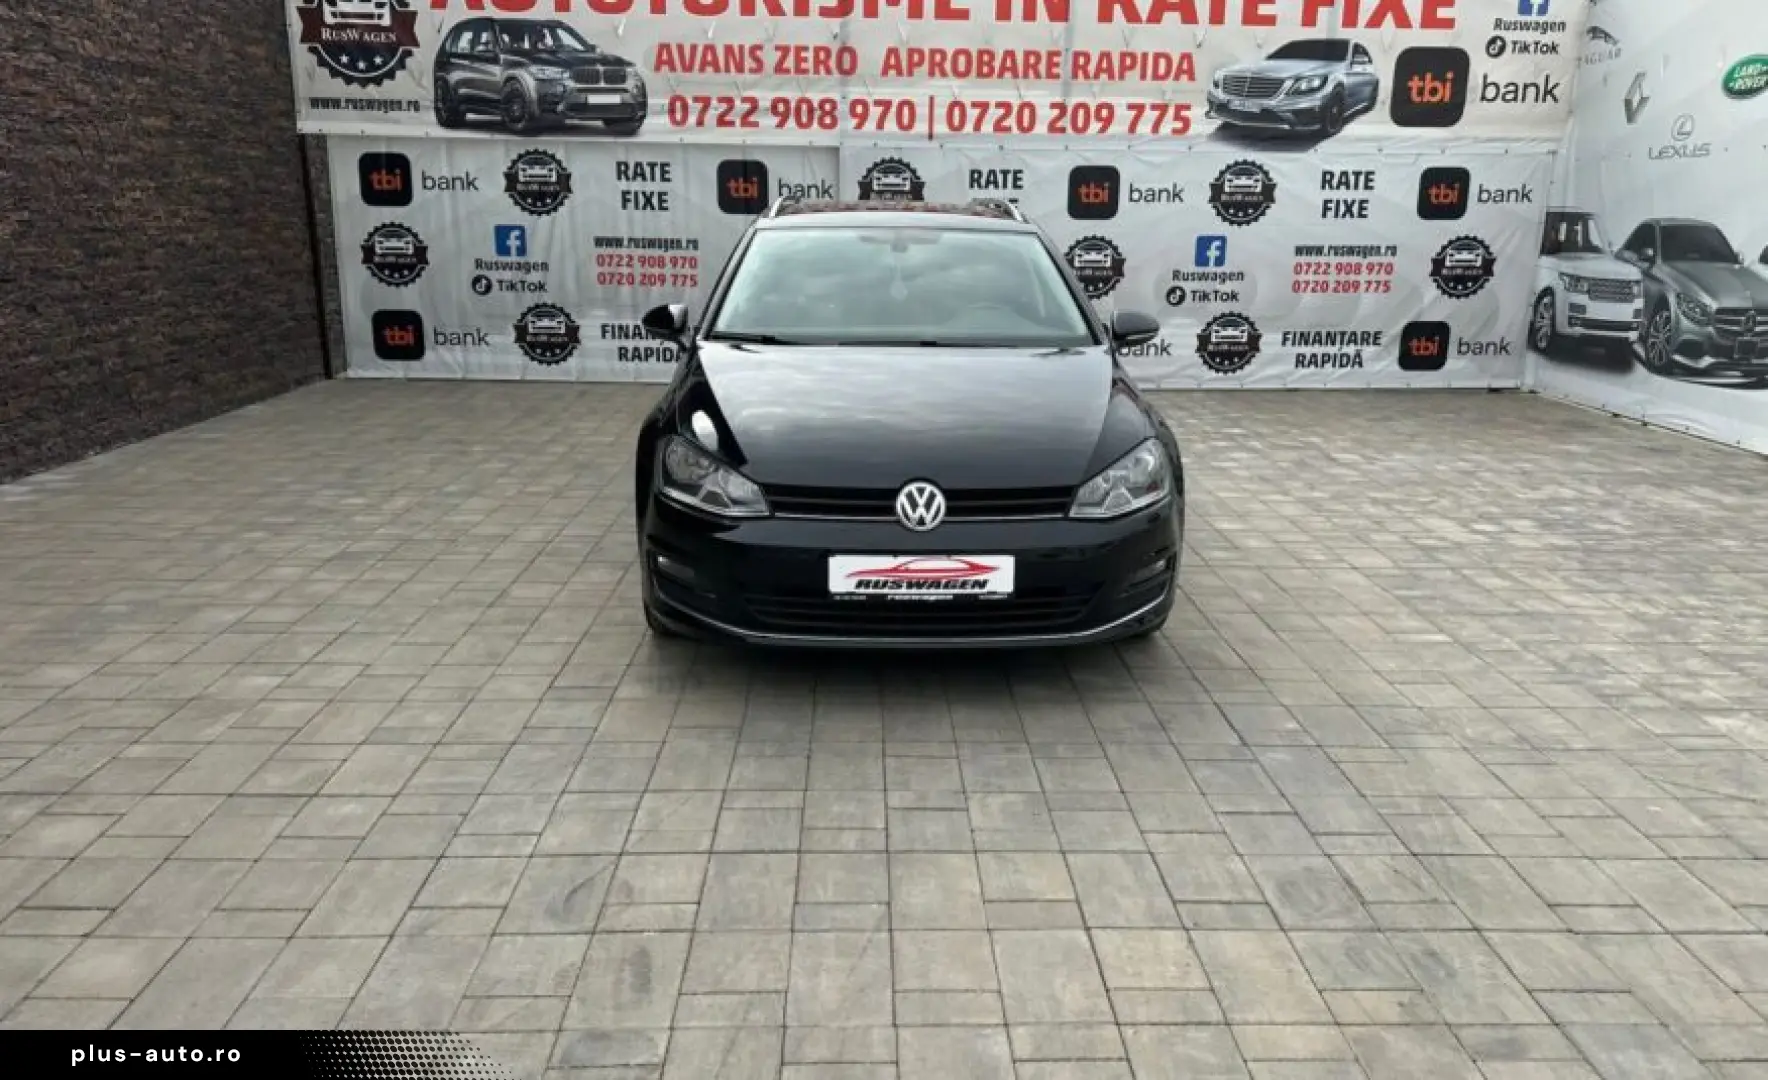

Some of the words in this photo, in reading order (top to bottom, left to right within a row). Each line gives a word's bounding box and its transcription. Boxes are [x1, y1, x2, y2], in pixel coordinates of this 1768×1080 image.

[1493, 17, 1567, 35] Ruswagen
[1511, 40, 1560, 55] TikTok
[653, 43, 764, 74] AVANS
[774, 44, 858, 76] ZERO
[881, 46, 1062, 80] APROBARE
[1071, 51, 1196, 81] RAPIDA
[1407, 71, 1454, 103] tbi
[1479, 73, 1560, 104] bank
[667, 94, 760, 128] 0722
[770, 96, 839, 130] 908
[849, 98, 917, 131] 970
[946, 101, 1036, 134] 0720
[1047, 102, 1115, 134] 209
[1126, 102, 1193, 136] 775
[1649, 142, 1713, 160] LEXUS
[369, 169, 402, 191] tbi
[421, 170, 479, 191] bank
[616, 161, 672, 182] RATE
[969, 169, 1024, 190] RATE
[1320, 170, 1376, 191] RATE
[727, 177, 759, 198] tbi
[1077, 182, 1110, 204] tbi
[1129, 182, 1185, 203] bank
[1428, 183, 1460, 204] tbi
[1477, 184, 1533, 203] bank
[620, 190, 670, 211] FIXE
[1321, 199, 1369, 219] FIXE
[474, 258, 550, 274] Ruswagen
[596, 254, 634, 268] 0722
[637, 254, 667, 269] 908
[669, 255, 698, 269] 970
[1293, 262, 1332, 276] 0722
[1334, 262, 1365, 276] 908
[1366, 261, 1394, 275] 970
[496, 279, 548, 292] TikTok
[596, 272, 635, 286] 0720
[638, 273, 667, 287] 209
[670, 273, 698, 287] 775
[1171, 270, 1245, 285] Ruswagen
[1291, 280, 1329, 294] 0720
[1332, 280, 1361, 293] 209
[1363, 280, 1392, 293] 775
[1190, 289, 1240, 303] TikTok
[384, 325, 414, 345] tbi
[433, 326, 491, 346] bank
[1408, 336, 1439, 356] tbi
[1456, 336, 1512, 356] bank
[853, 578, 990, 590] RUSWAGEN
